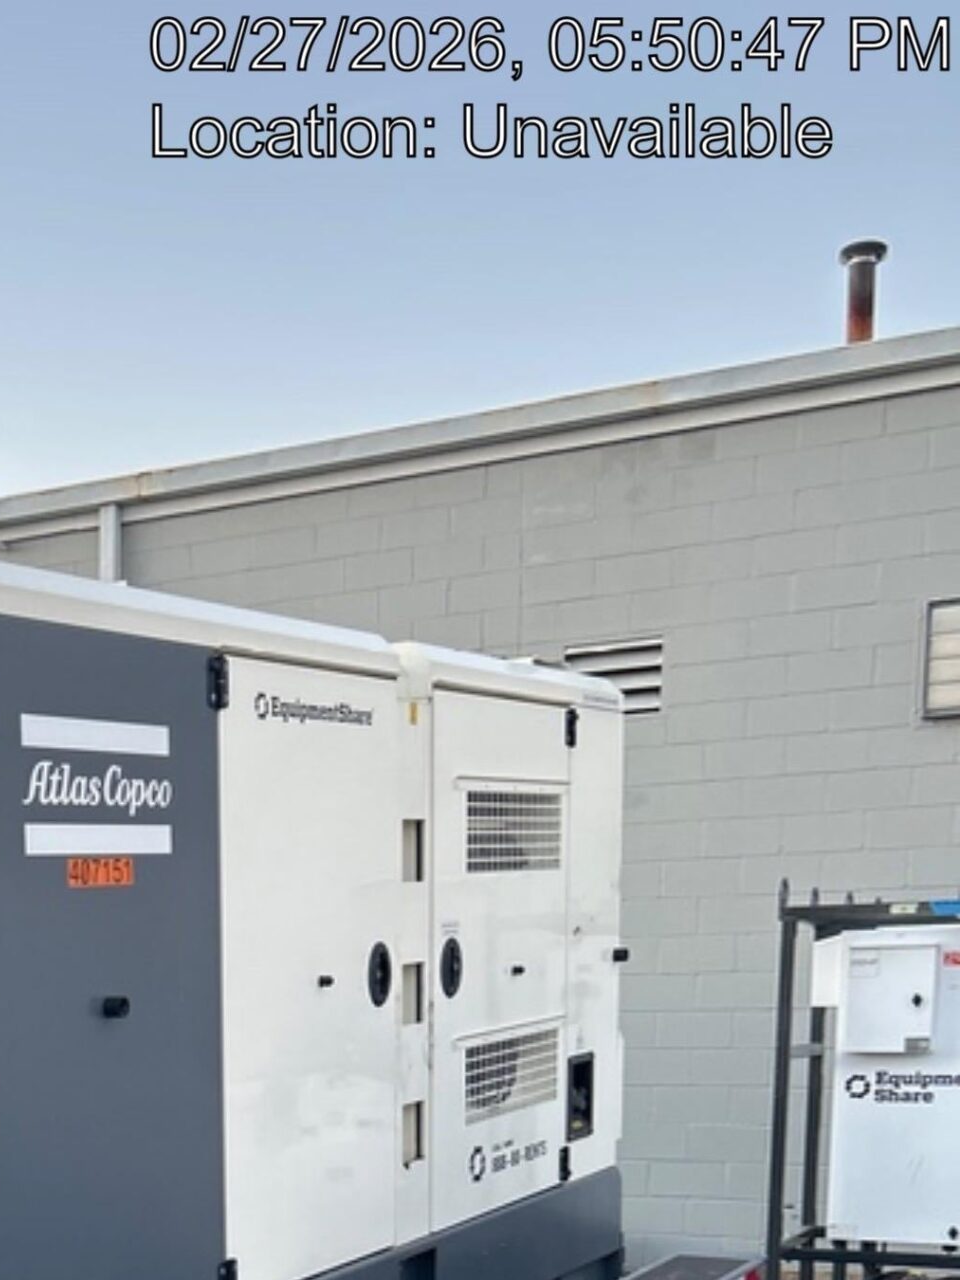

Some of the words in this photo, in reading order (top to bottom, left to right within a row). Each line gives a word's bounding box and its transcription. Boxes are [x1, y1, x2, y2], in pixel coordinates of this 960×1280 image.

[271, 696, 372, 726] EquipmentShare
[22, 760, 102, 806] Atlas
[103, 764, 172, 817] Copco
[69, 858, 131, 885] 407151
[874, 1089, 935, 1103] Share
